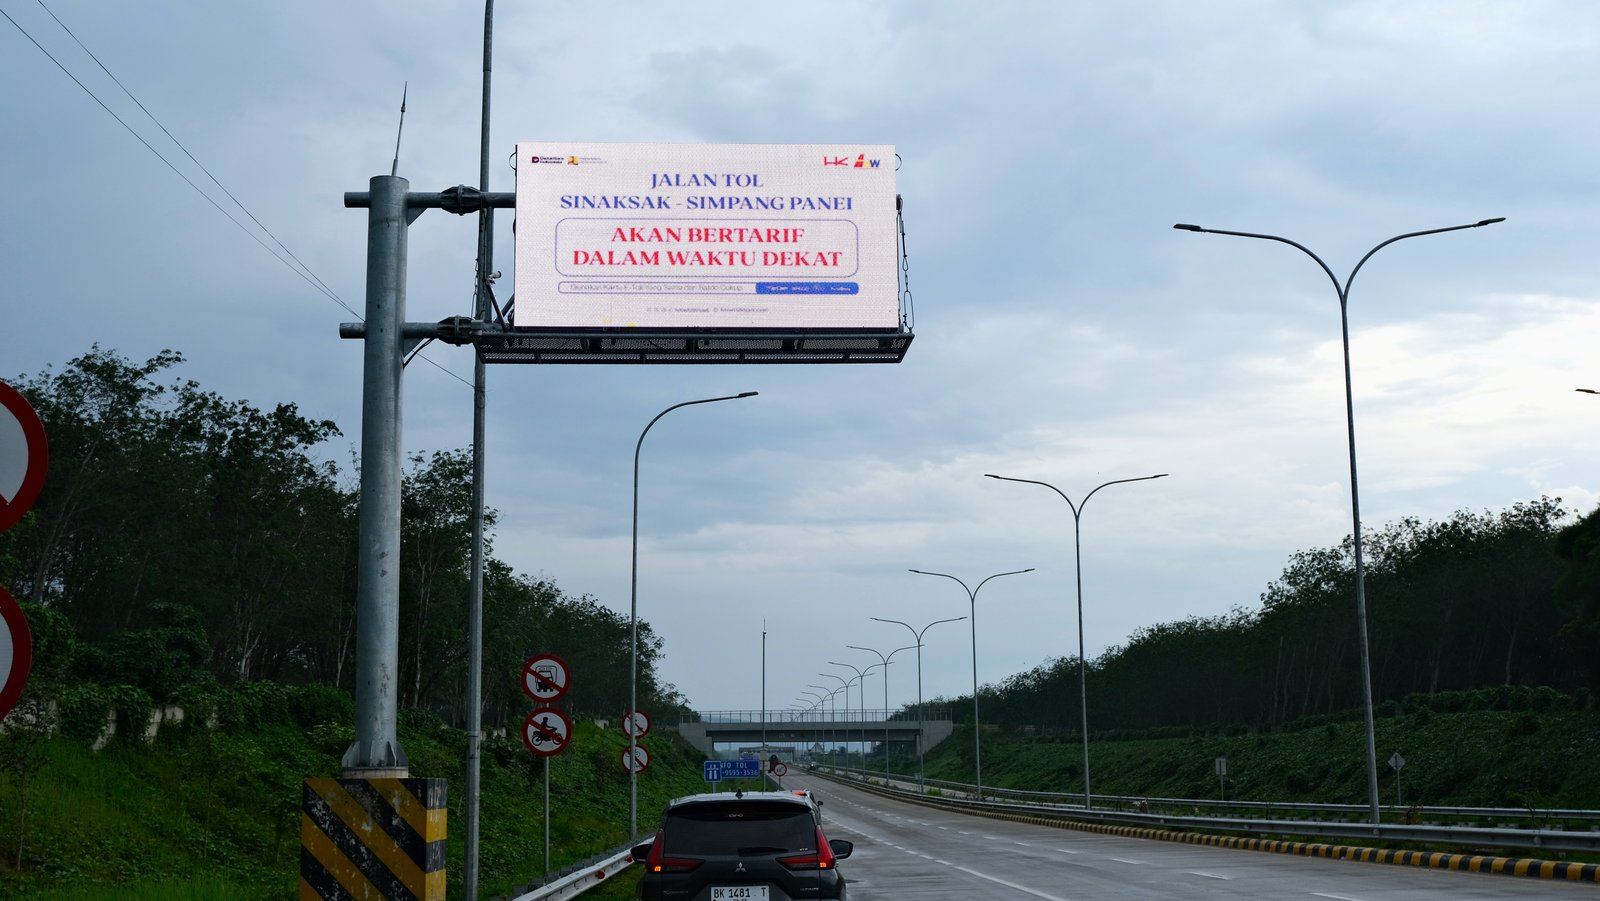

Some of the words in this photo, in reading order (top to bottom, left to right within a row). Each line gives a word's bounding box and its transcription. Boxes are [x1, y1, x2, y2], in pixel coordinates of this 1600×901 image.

[651, 173, 717, 189] JALAN
[722, 174, 763, 187] TOL
[560, 195, 671, 209] SINAKSAK
[687, 196, 784, 210] SIMPANG
[790, 197, 852, 210] PANEI
[611, 227, 681, 242] AKAN
[688, 228, 804, 243] BERTARIF
[573, 250, 660, 266] DALAM
[667, 251, 755, 266] WAKTU
[763, 251, 843, 266] DEKAT
[714, 888, 724, 898] BK
[728, 888, 750, 898] 1481
[760, 887, 766, 897] T
